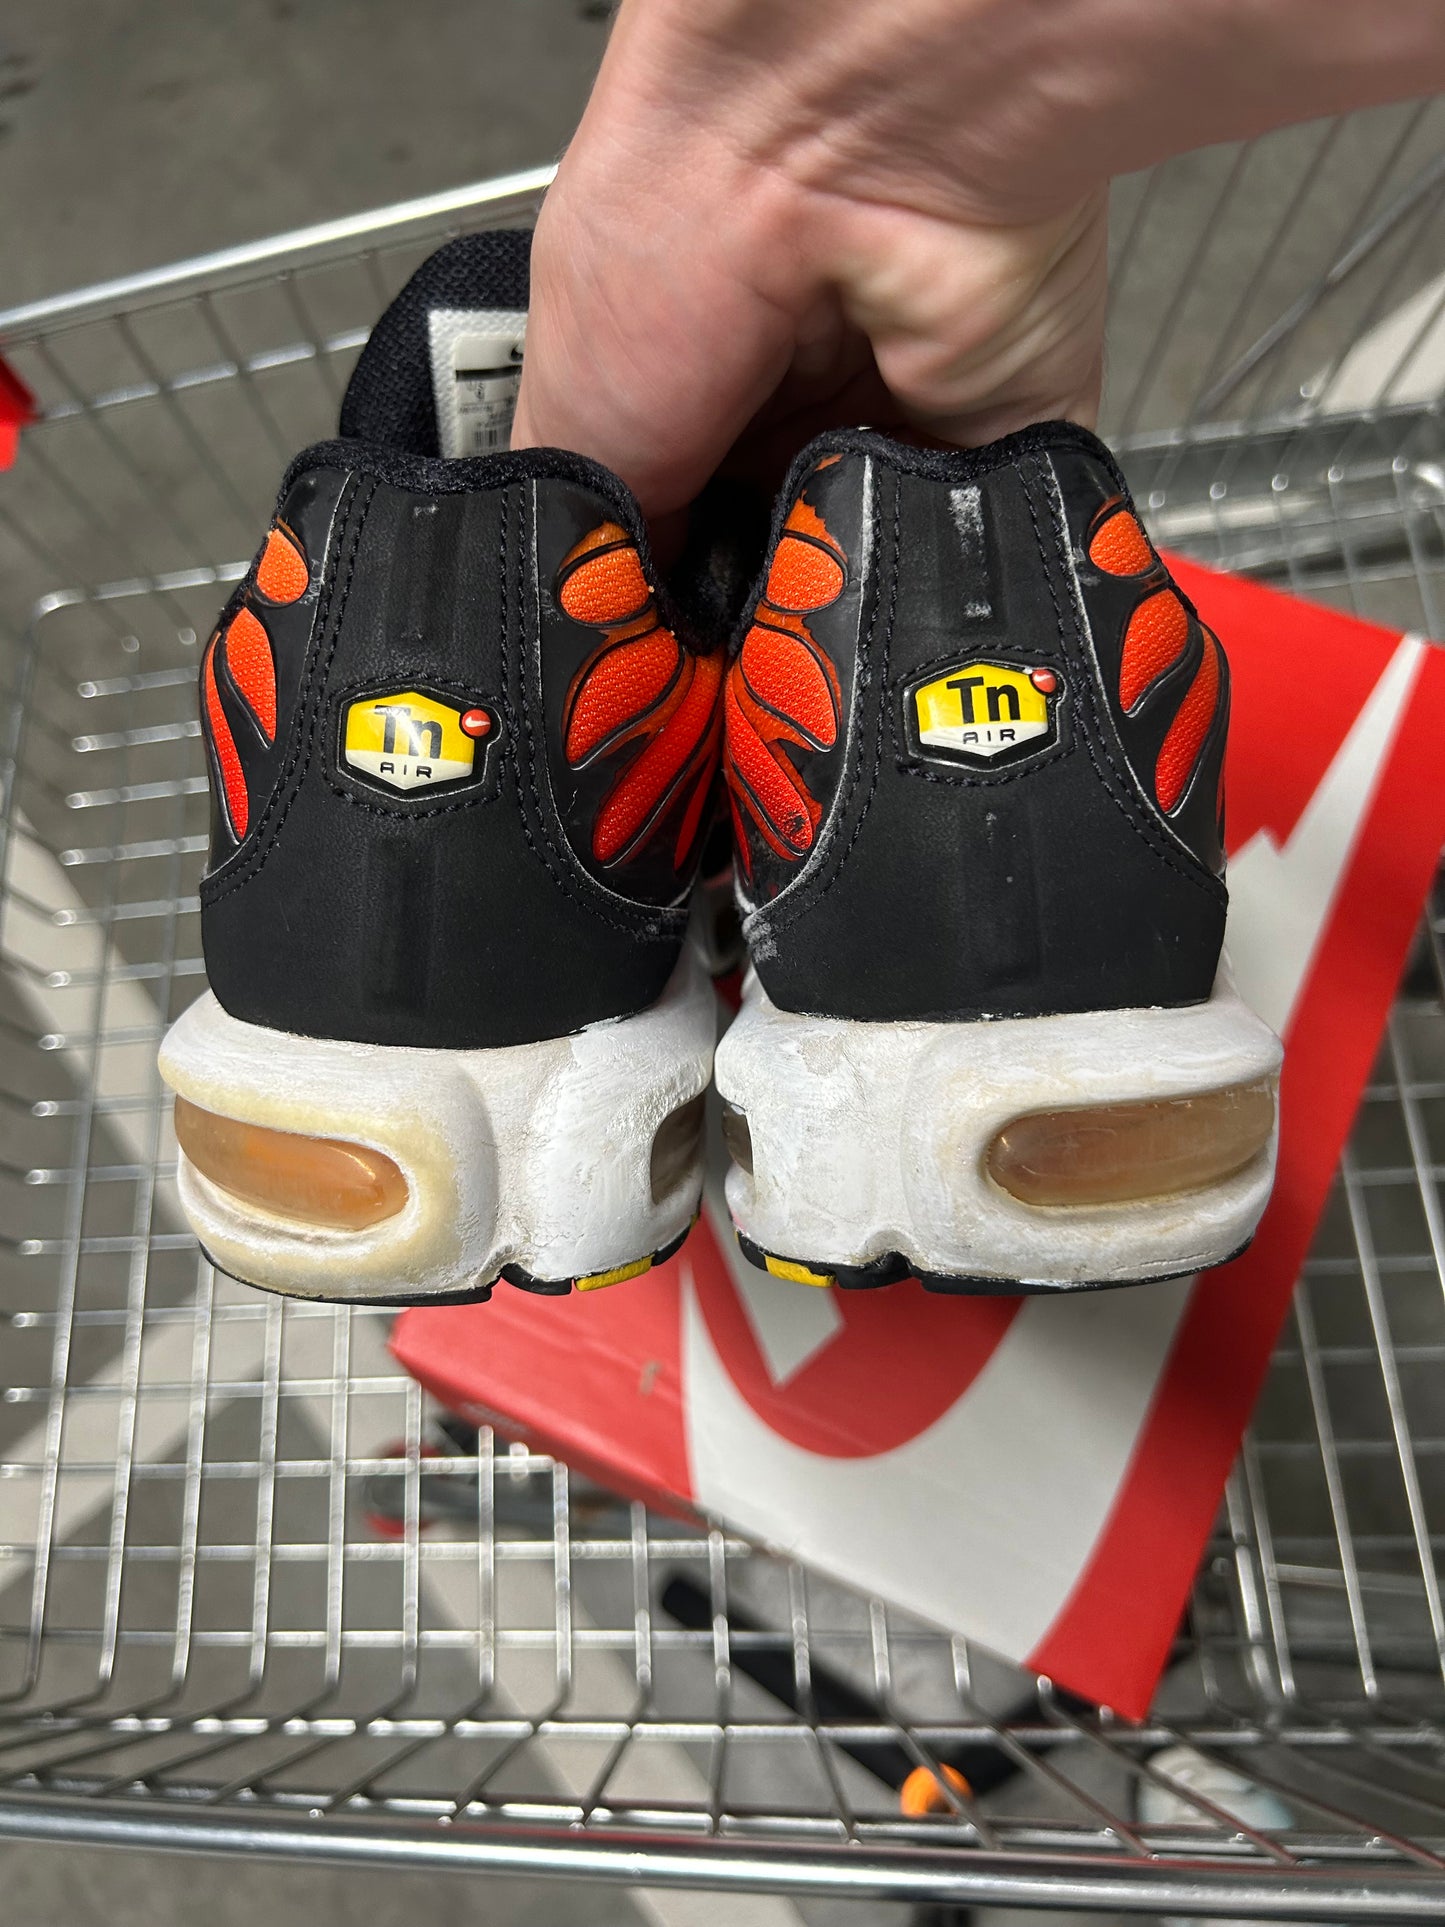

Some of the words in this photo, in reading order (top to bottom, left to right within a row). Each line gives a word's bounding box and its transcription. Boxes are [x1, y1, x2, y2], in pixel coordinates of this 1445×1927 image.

[946, 676, 1021, 724] Tn
[374, 704, 443, 760] Tn
[963, 728, 1016, 744] AIR
[379, 761, 433, 779] AIR
